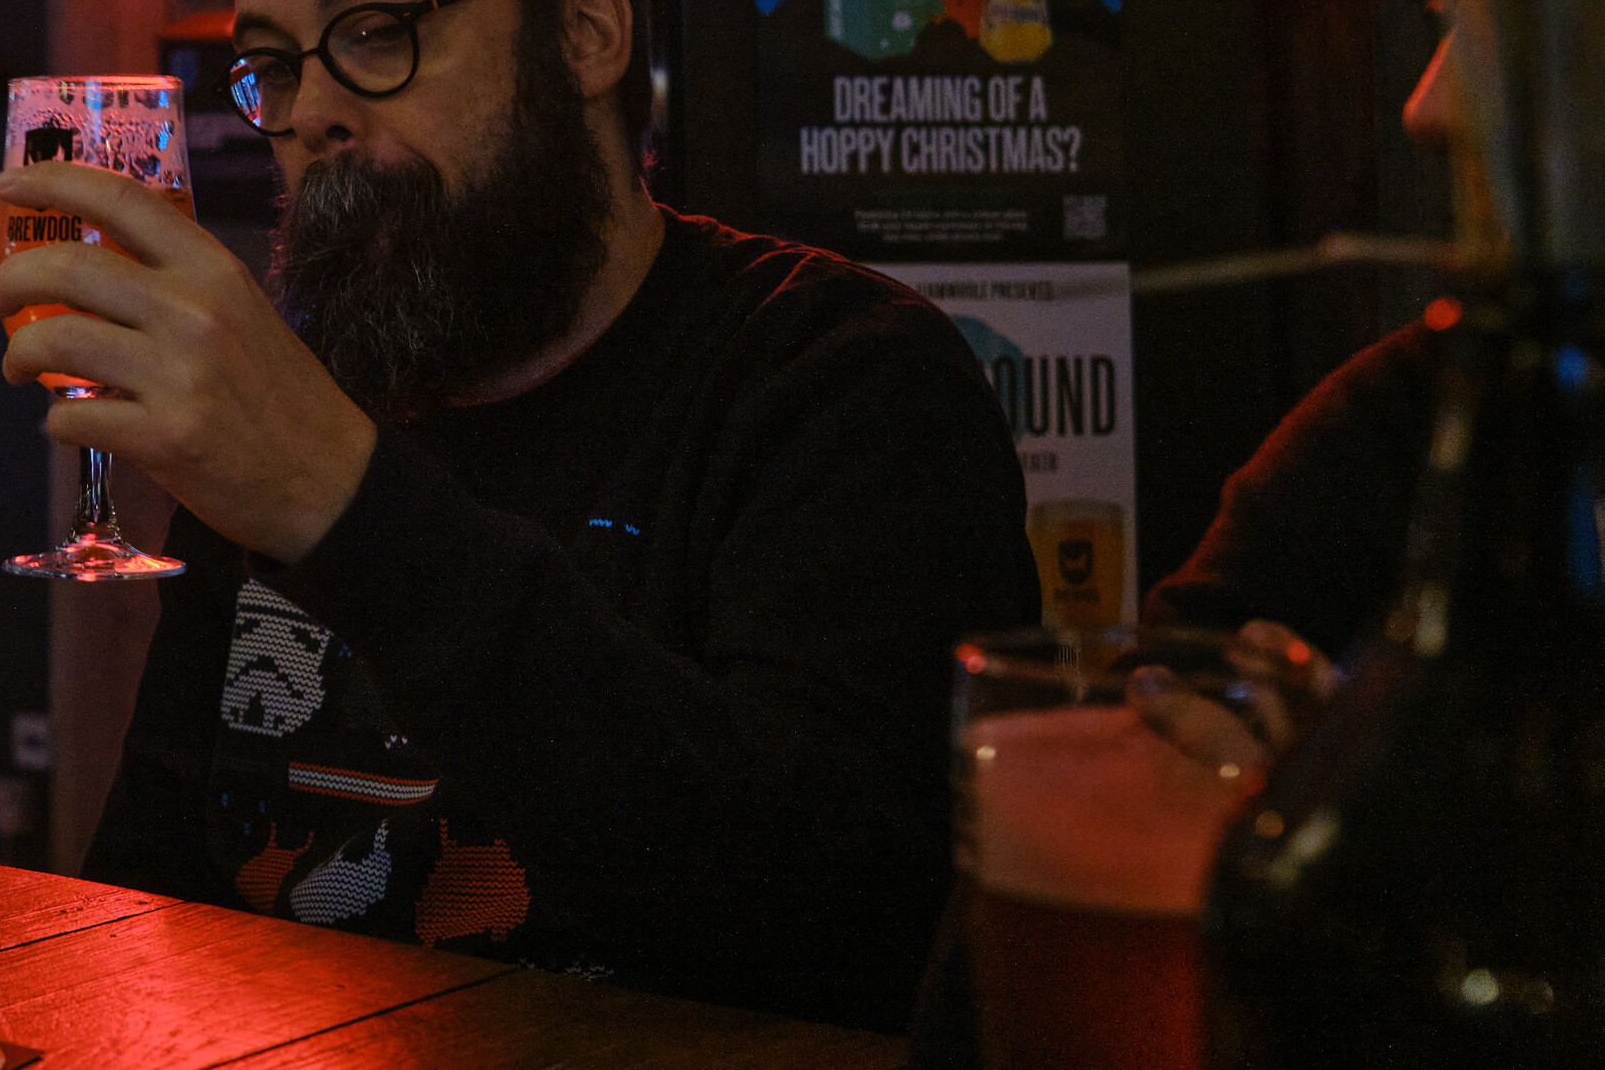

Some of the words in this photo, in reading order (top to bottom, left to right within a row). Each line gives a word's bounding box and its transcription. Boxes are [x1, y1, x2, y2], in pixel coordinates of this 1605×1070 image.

[834, 76, 982, 123] DREAMING
[988, 76, 1025, 120] OF
[1029, 76, 1048, 120] A
[801, 127, 897, 175] HOPPY
[900, 125, 1083, 174] CHRISTMAS?
[7, 215, 82, 243] BREWDOG
[991, 354, 1117, 438] OUND
